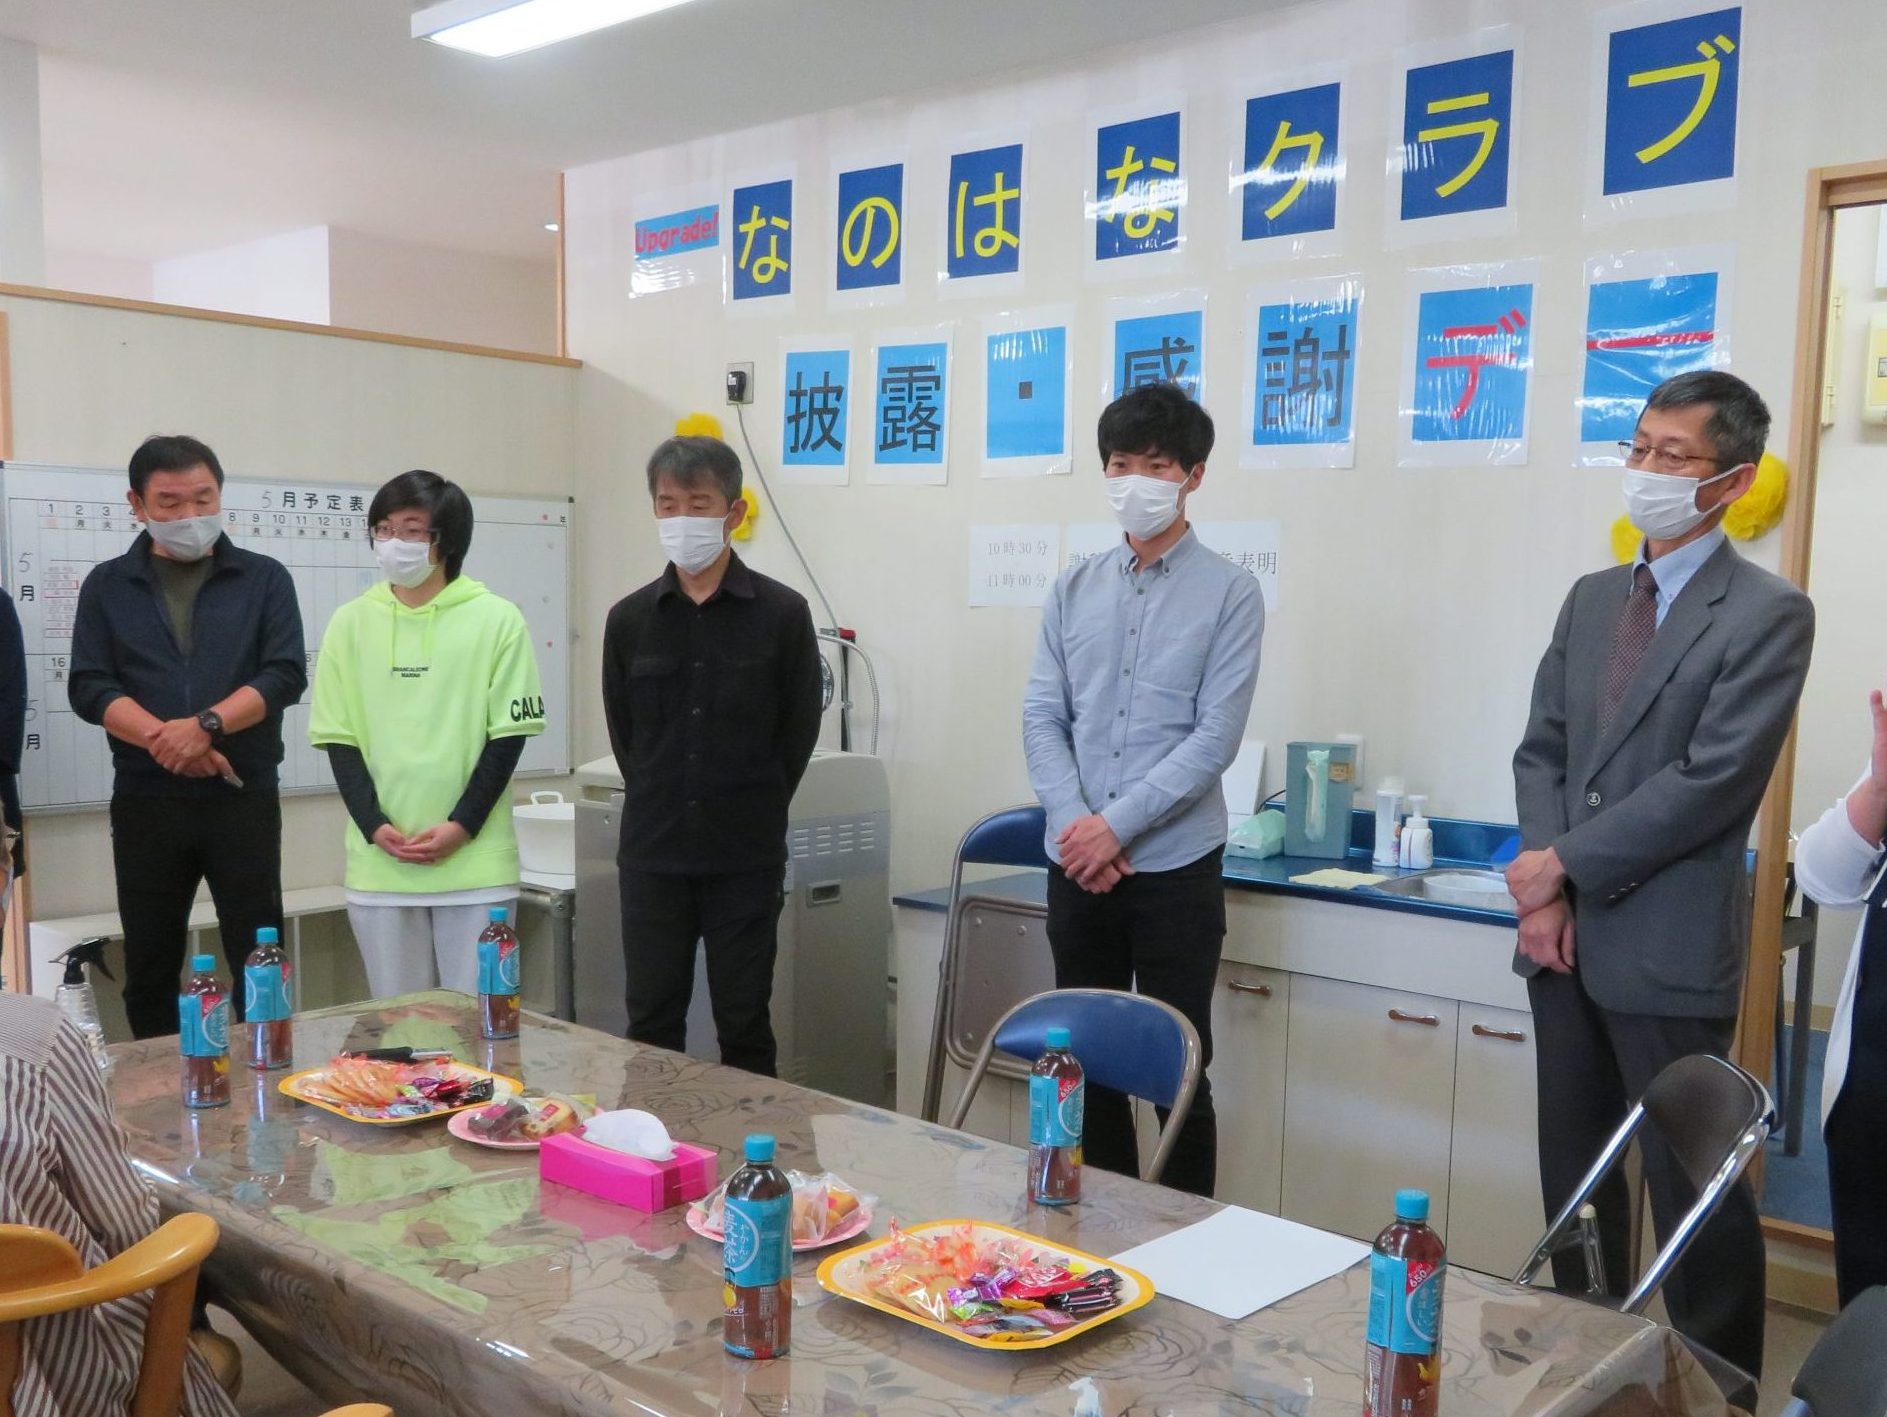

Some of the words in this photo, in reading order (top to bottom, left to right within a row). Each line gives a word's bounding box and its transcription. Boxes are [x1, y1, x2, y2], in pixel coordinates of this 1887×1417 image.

[635, 211, 719, 253] Upgrade!
[75, 504, 84, 516] 2
[102, 506, 111, 517] 3
[228, 512, 237, 523] 8
[251, 513, 260, 523] 9
[272, 514, 286, 525] 10
[296, 515, 308, 525] 11
[318, 516, 331, 527] 12
[340, 518, 352, 528] 13
[988, 540, 1048, 556] 10時30分
